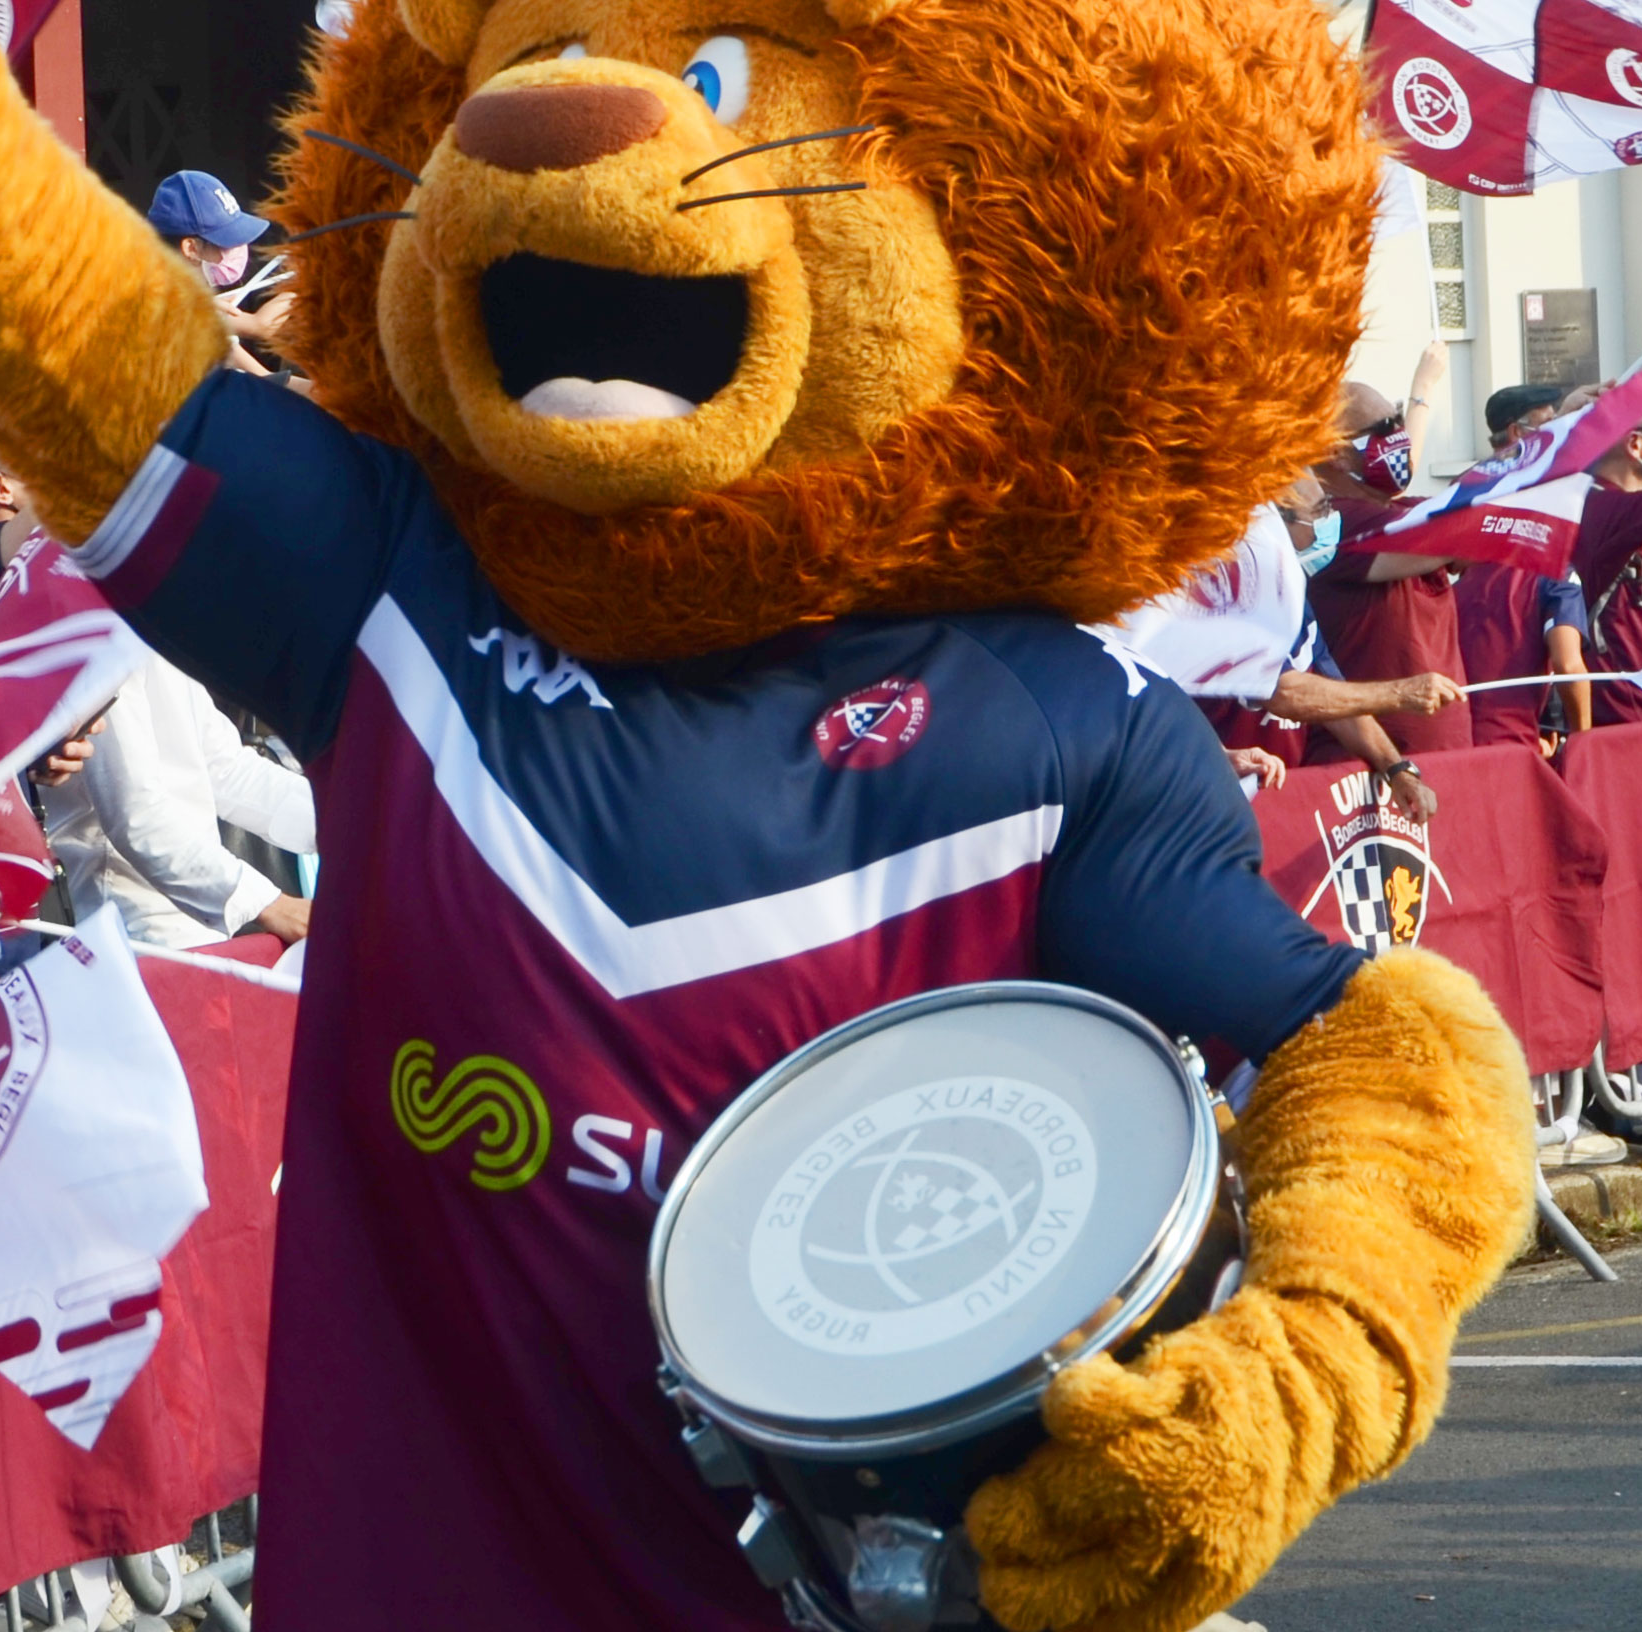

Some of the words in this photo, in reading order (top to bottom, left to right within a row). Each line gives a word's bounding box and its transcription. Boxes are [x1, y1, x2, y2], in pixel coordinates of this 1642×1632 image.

[898, 696, 925, 744] BEGLES
[1329, 770, 1399, 816] UNIO
[1330, 812, 1382, 851] BORDEAUX
[1378, 806, 1424, 844] BEGLES
